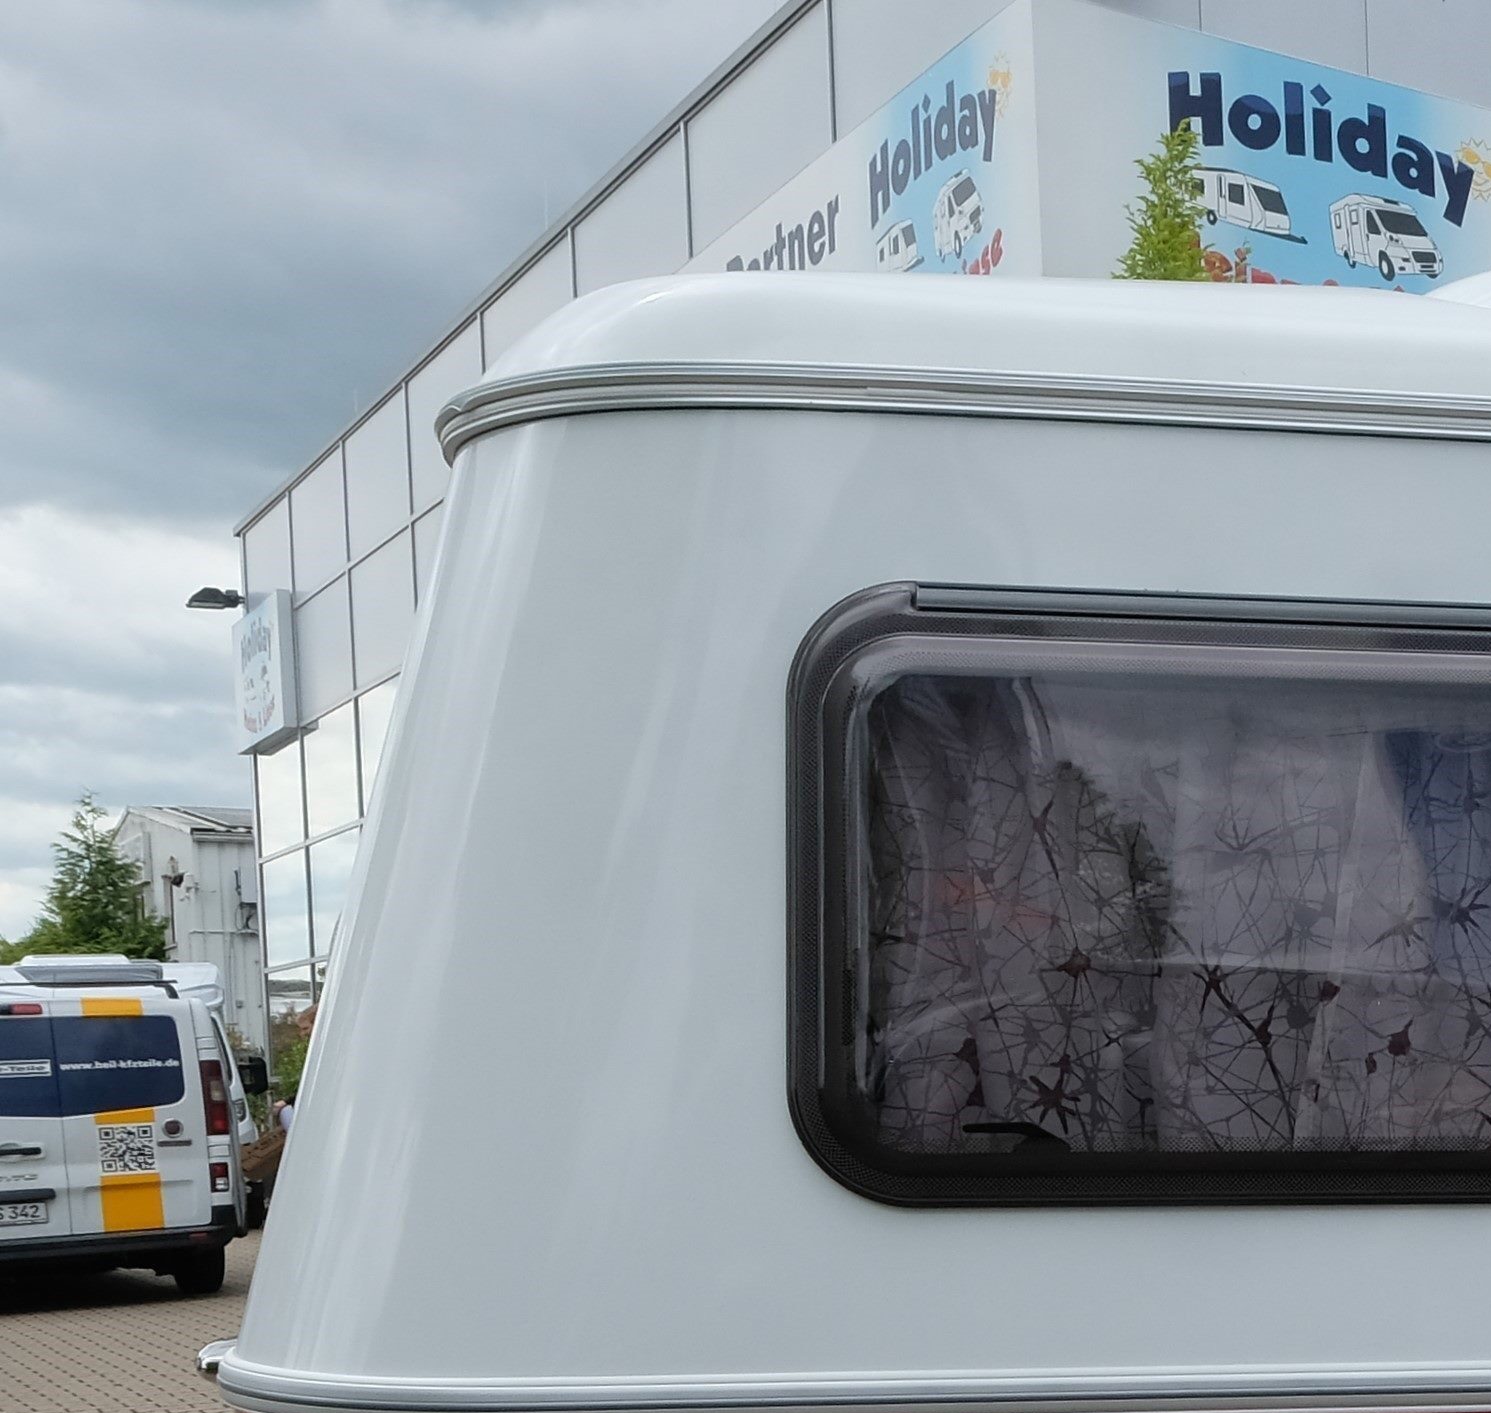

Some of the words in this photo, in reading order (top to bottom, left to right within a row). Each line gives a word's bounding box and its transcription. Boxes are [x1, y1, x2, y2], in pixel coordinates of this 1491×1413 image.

[869, 79, 997, 230] Holiday
[1167, 70, 1475, 228] Holiday
[8, 1204, 40, 1219] 342
